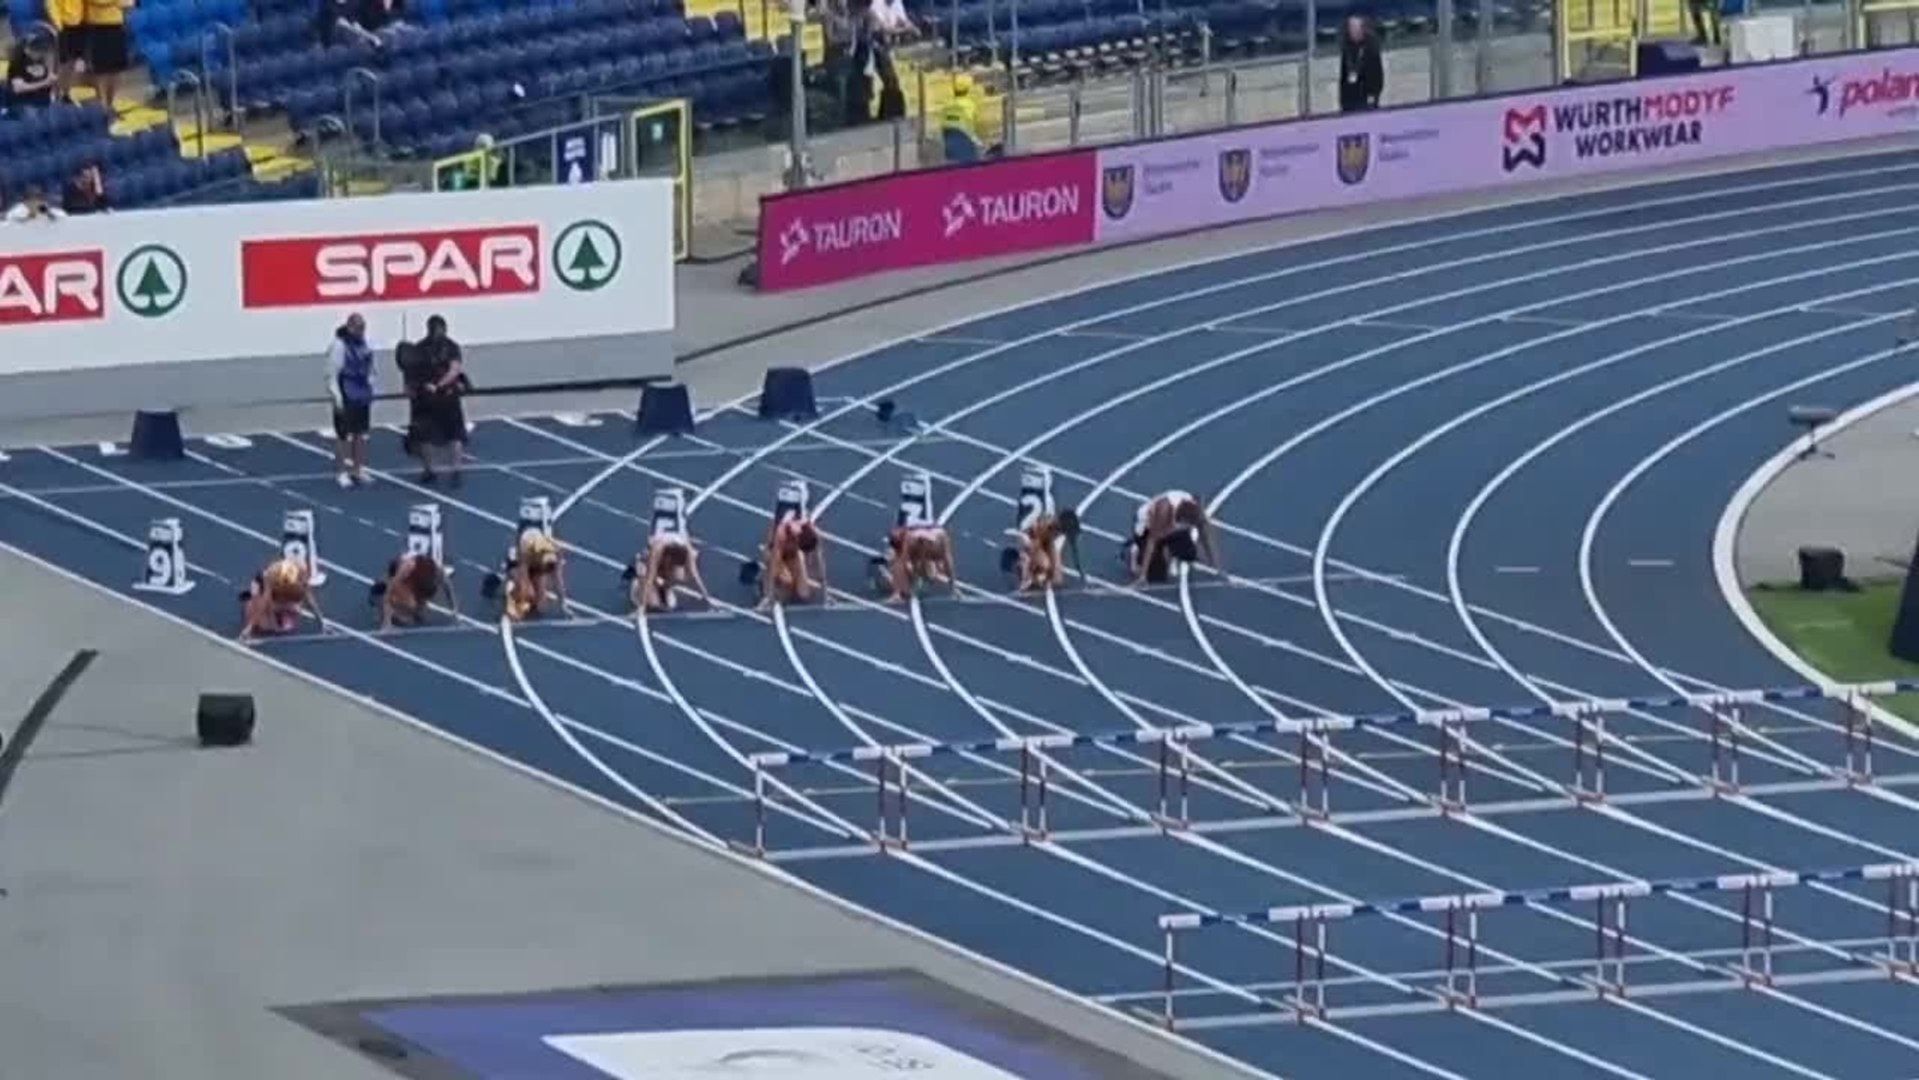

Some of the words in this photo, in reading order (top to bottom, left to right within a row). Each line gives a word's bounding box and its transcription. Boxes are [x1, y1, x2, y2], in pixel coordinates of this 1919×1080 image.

[1576, 121, 1703, 158] WORKWEAR
[980, 185, 1079, 226] TAURON
[812, 209, 902, 250] TAURON
[316, 235, 536, 297] SPAR
[148, 548, 172, 586] 9
